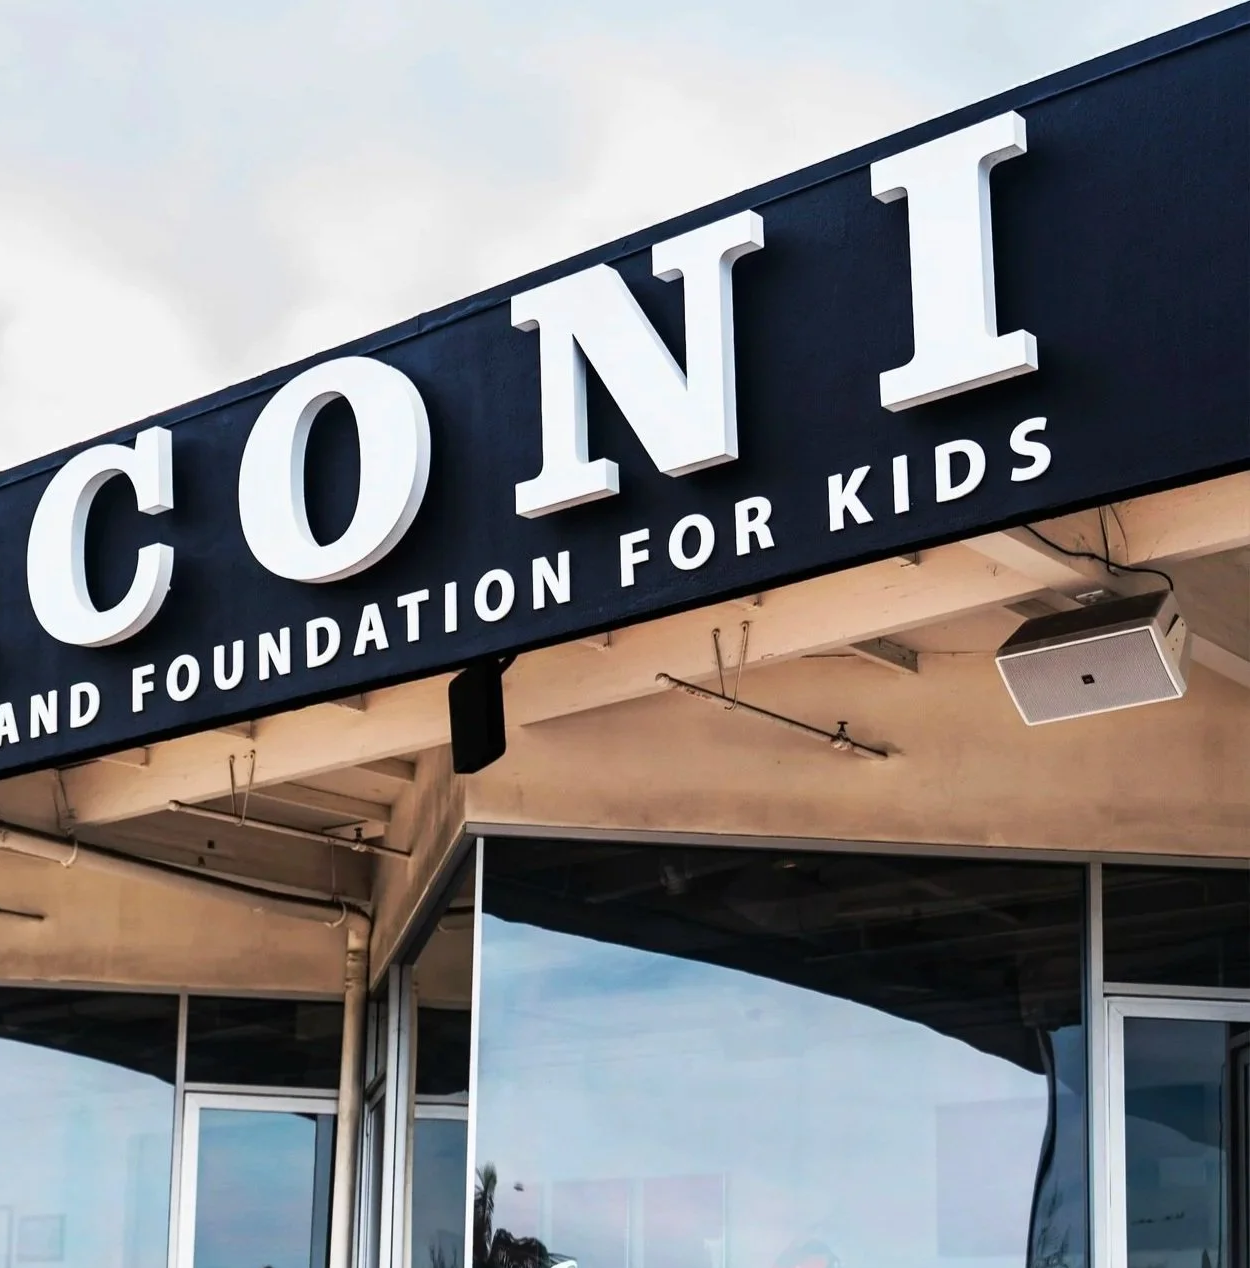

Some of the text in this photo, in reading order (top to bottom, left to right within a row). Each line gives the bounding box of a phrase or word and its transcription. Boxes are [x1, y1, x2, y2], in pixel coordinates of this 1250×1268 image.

[132, 550, 571, 713] FOUNDATION
[619, 496, 775, 588] FOR
[827, 416, 1052, 532] KIDS
